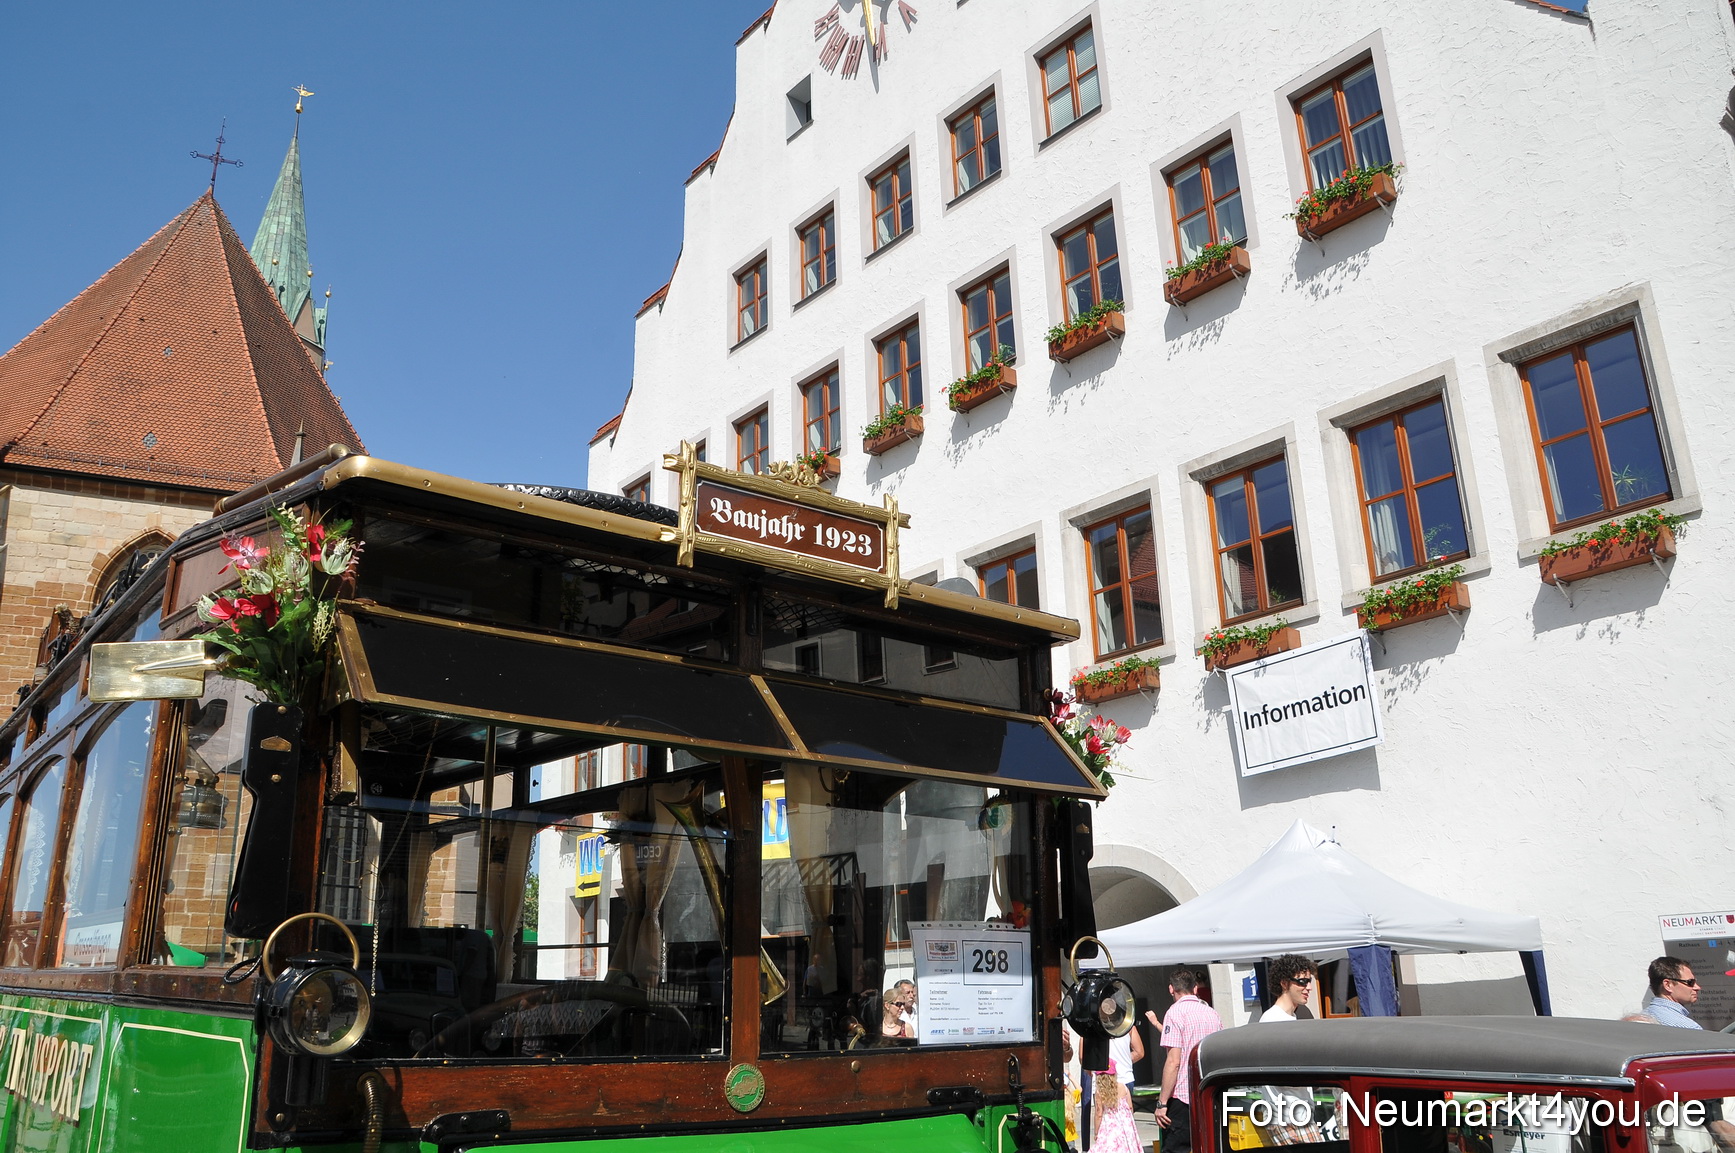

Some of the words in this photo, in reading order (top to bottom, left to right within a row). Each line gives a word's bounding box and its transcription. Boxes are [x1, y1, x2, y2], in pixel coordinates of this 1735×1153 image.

[709, 497, 806, 545] Baujahr
[812, 522, 874, 557] 1923
[1243, 684, 1367, 731] Information
[577, 833, 607, 877] WC
[1662, 914, 1723, 928] NEUMARKT
[972, 948, 1009, 974] 298
